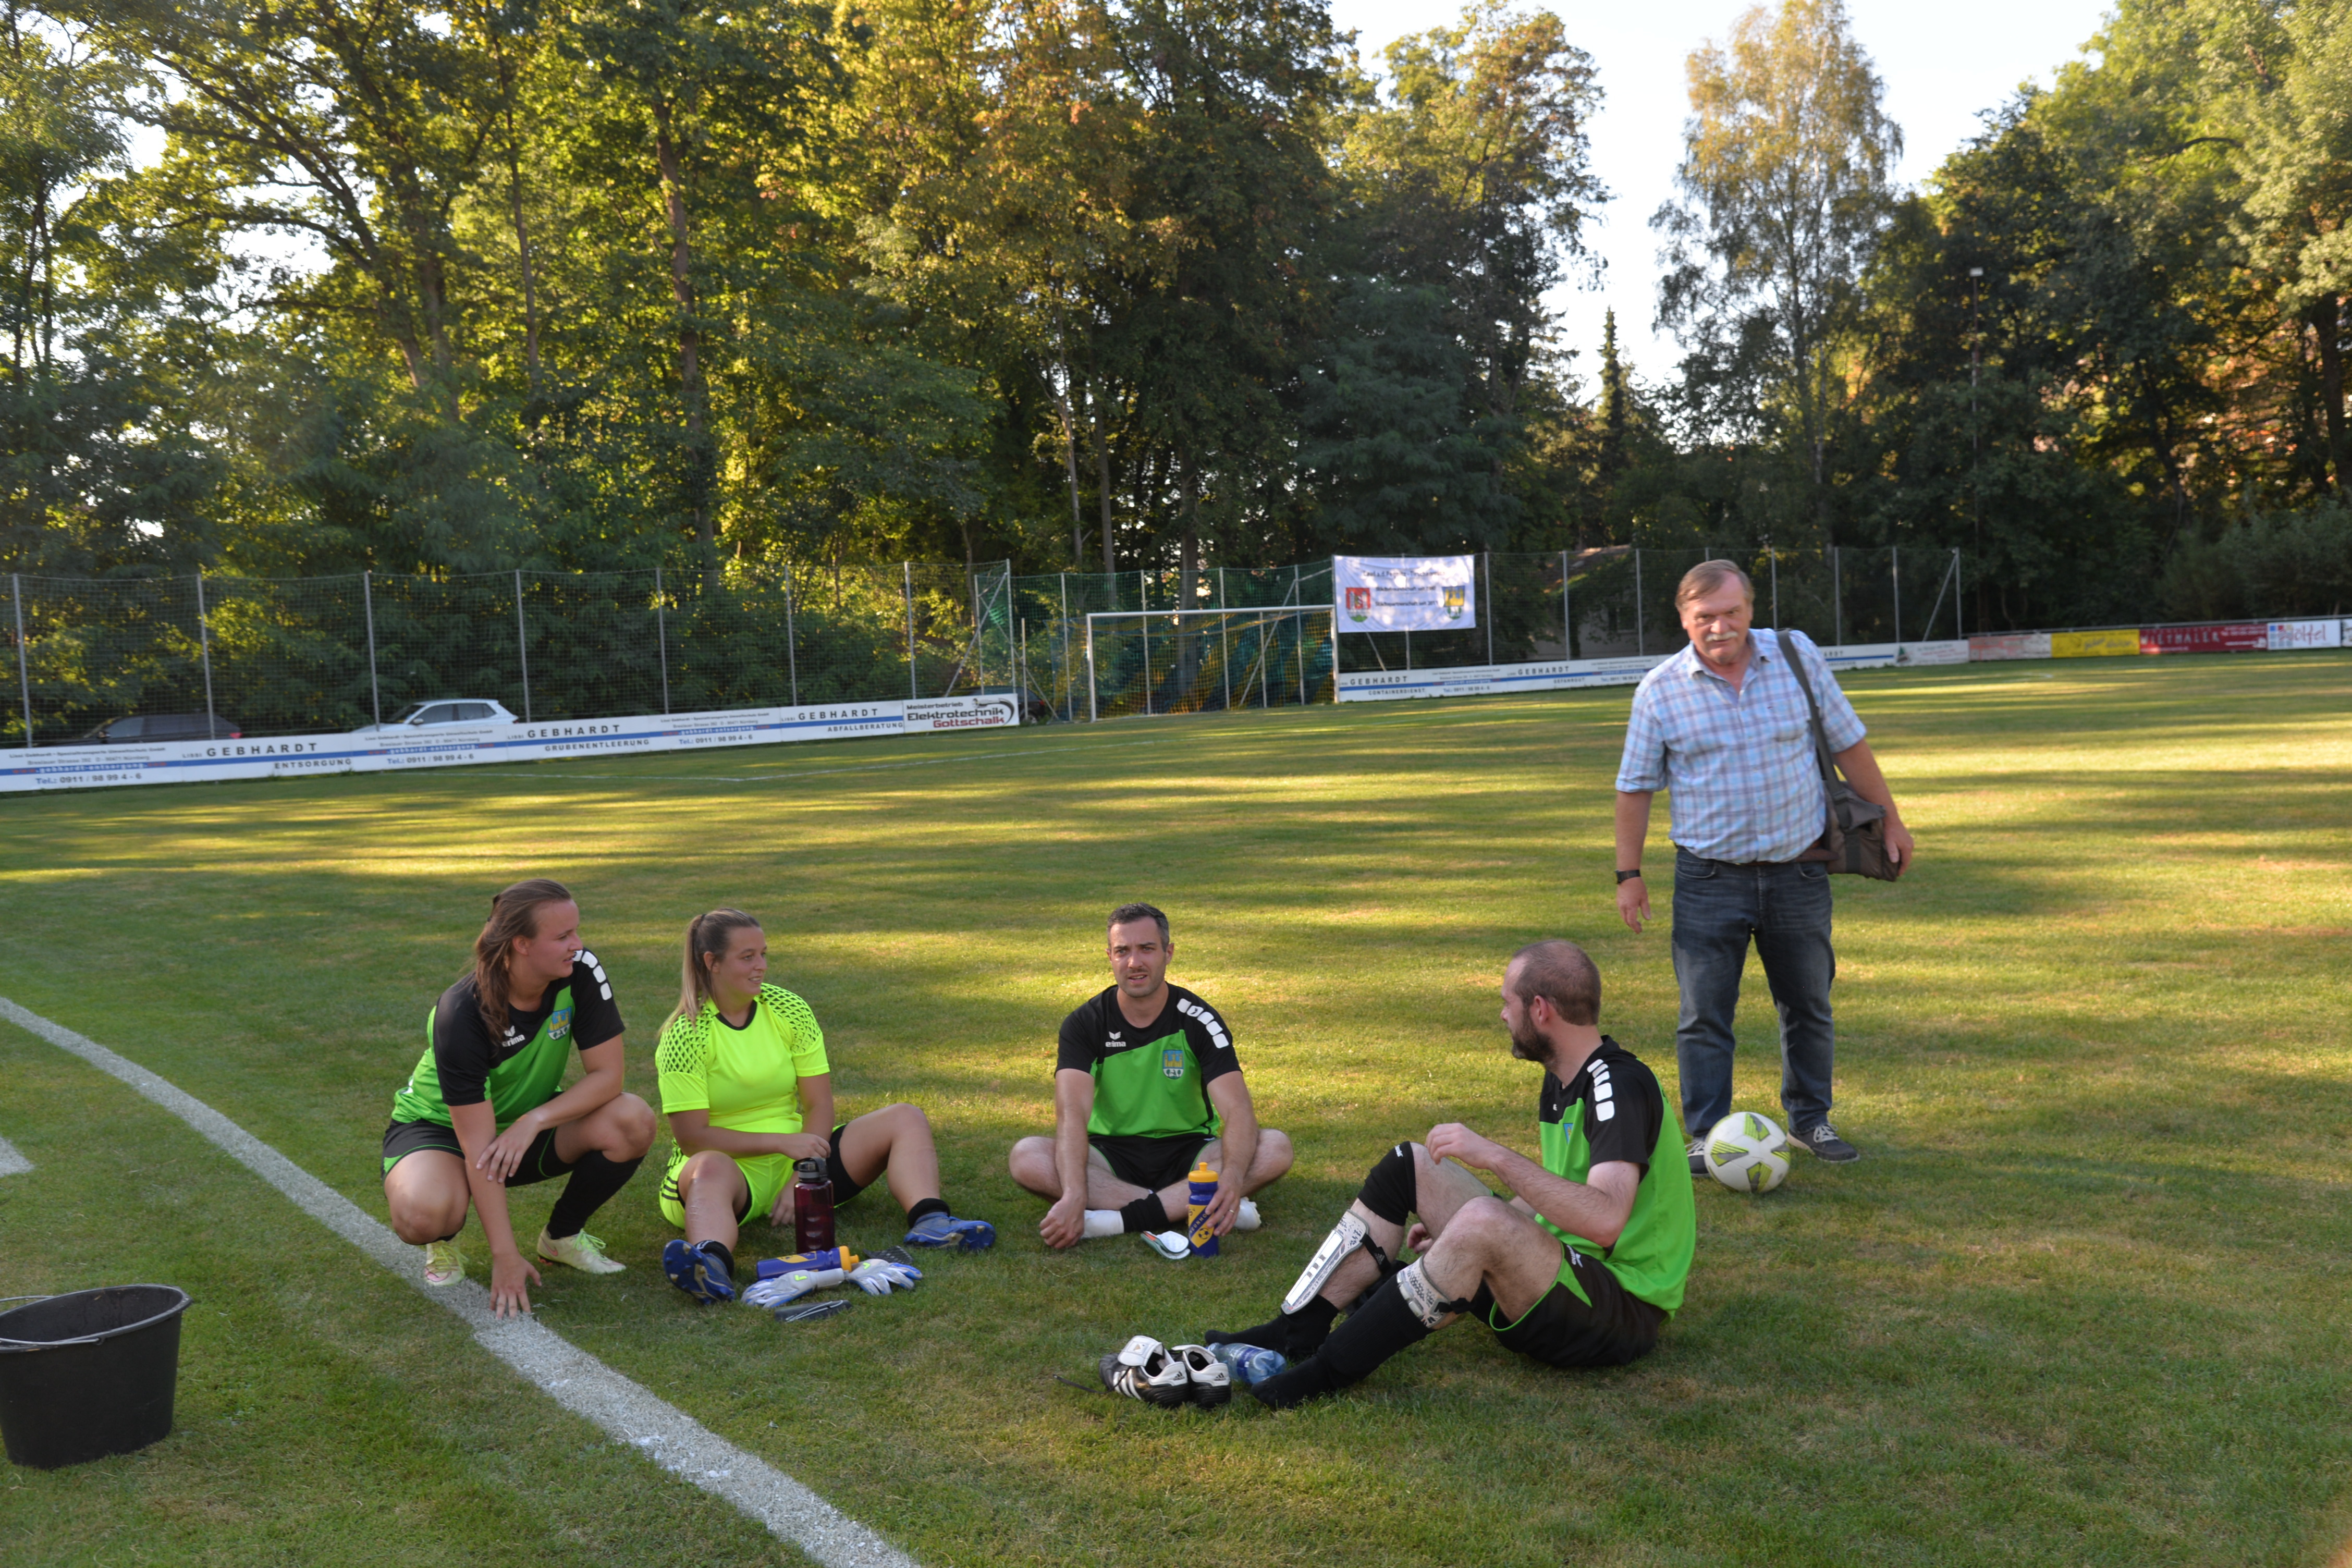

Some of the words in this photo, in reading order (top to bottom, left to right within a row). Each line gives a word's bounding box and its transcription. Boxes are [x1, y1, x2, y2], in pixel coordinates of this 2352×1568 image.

[1518, 666, 1569, 675] GEBHARDT
[1350, 676, 1407, 685] GEBHARDT
[799, 708, 877, 720] GEBHARDT
[908, 708, 1004, 720] Elektrotechnik
[828, 722, 903, 732] ABFALLBERATUNG
[933, 716, 1005, 728] Gottschalk
[528, 725, 620, 738] GEBHARDT
[207, 743, 317, 757] GEBHARDT
[545, 739, 650, 751] GRUBENENTLEERUNG
[274, 758, 352, 769] ENTSORGUNG
[501, 1034, 525, 1047] erima
